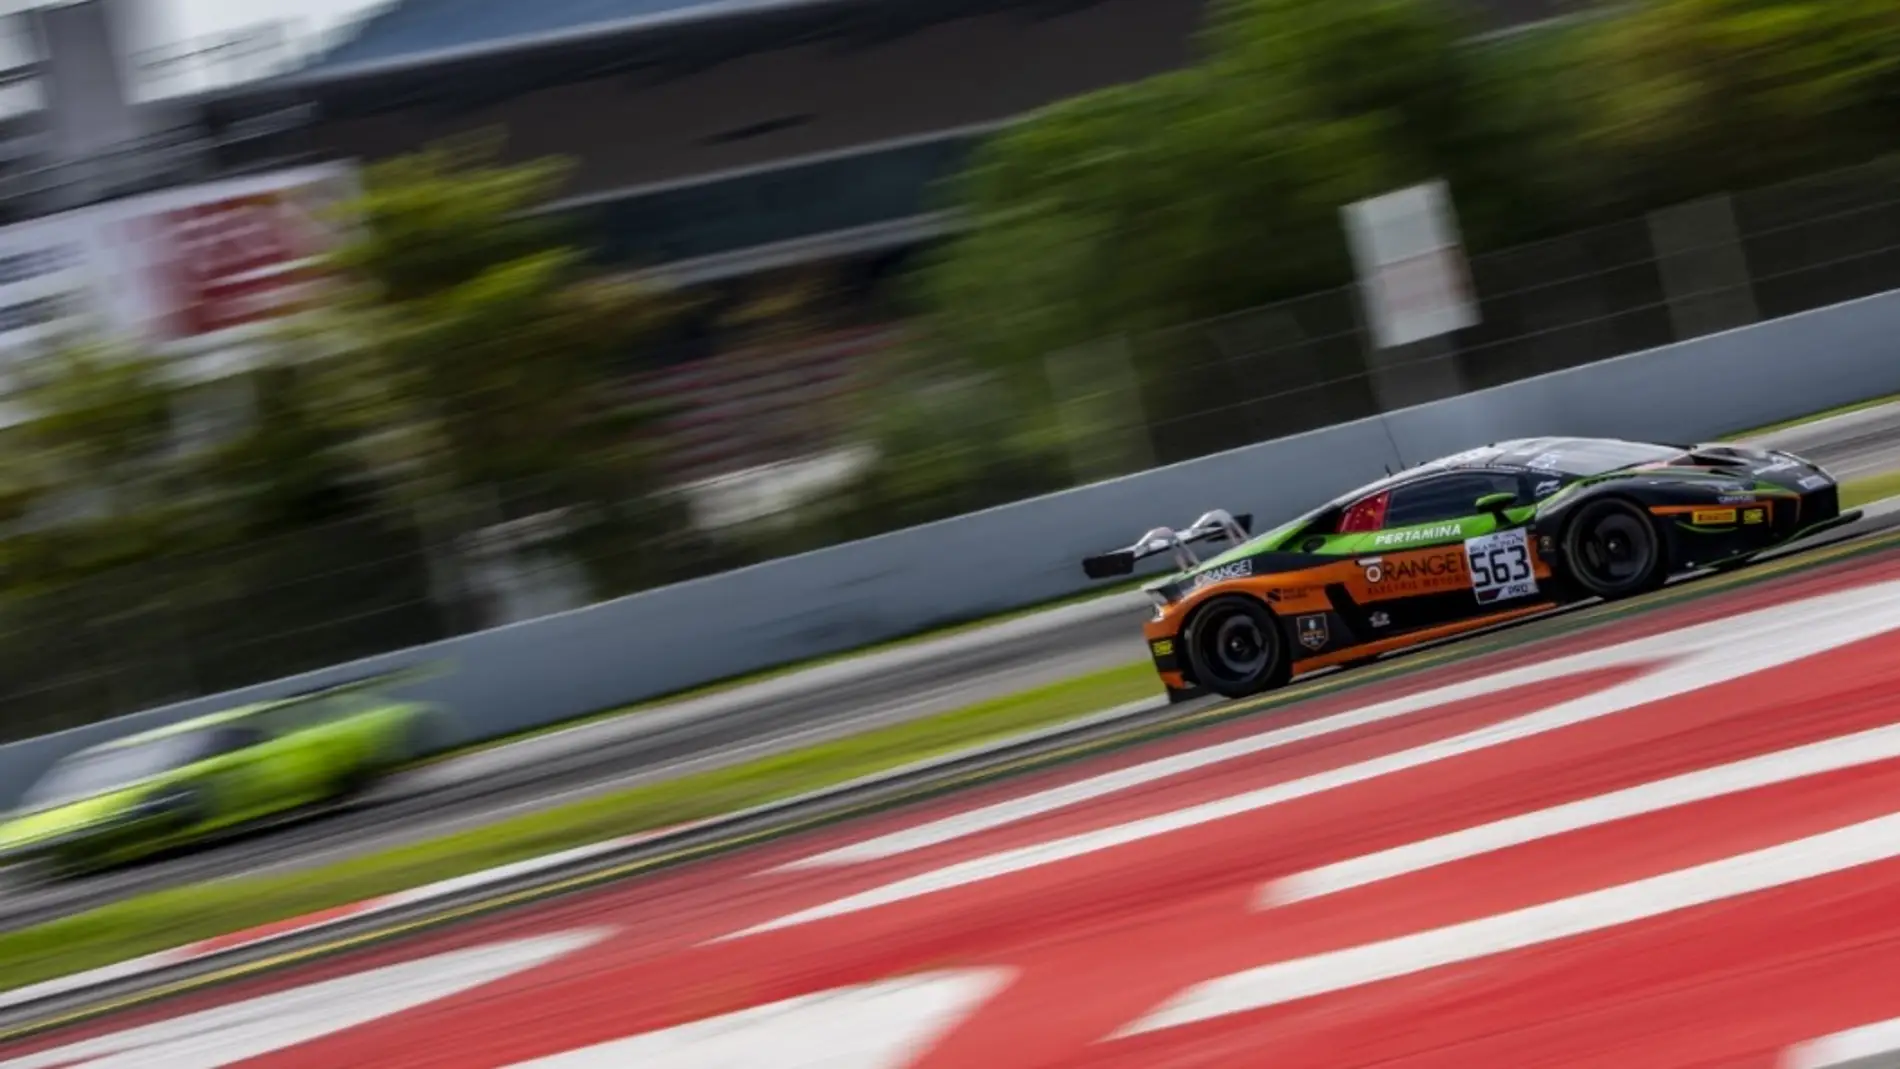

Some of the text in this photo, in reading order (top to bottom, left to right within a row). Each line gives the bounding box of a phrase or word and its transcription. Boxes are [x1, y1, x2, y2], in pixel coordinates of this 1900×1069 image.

[1375, 524, 1462, 545] PERTAMINA
[1469, 545, 1530, 587] 563
[1507, 583, 1528, 595] PRO
